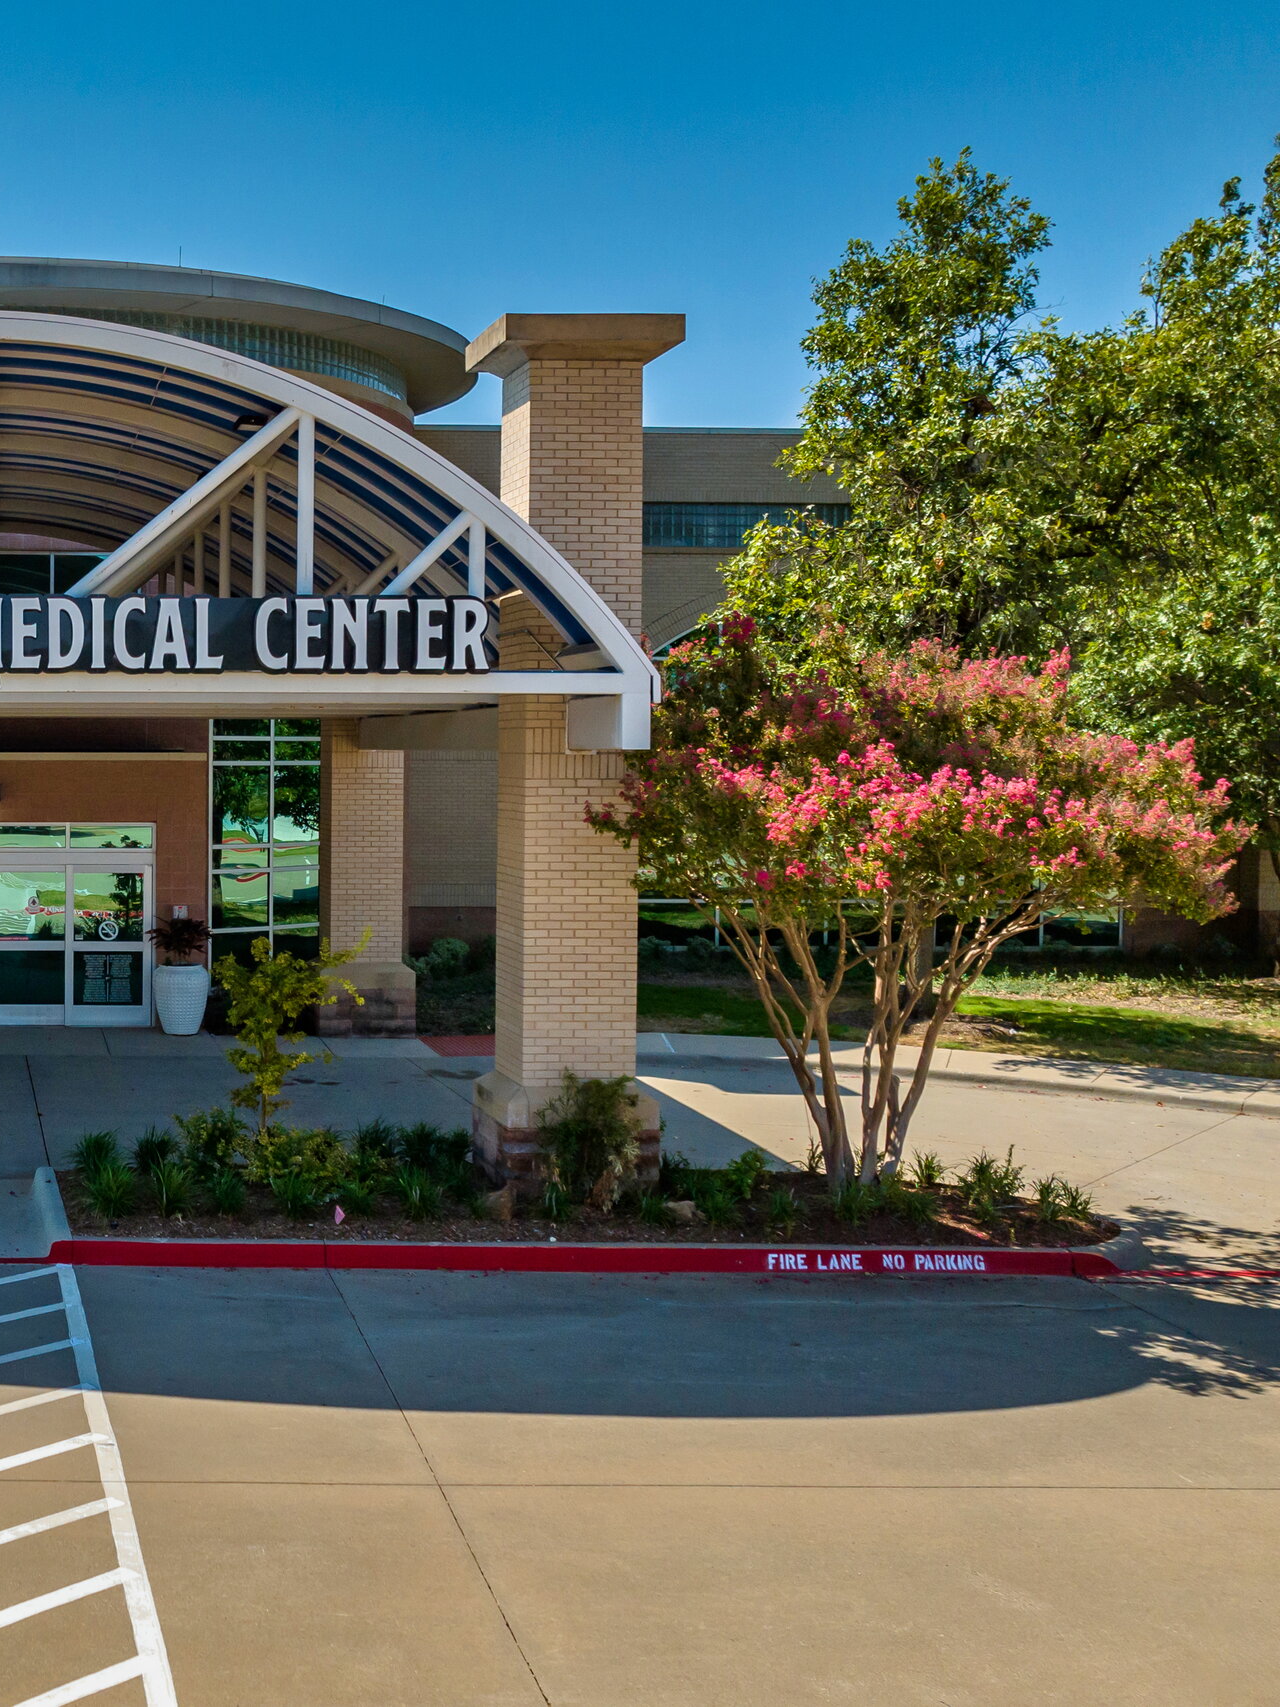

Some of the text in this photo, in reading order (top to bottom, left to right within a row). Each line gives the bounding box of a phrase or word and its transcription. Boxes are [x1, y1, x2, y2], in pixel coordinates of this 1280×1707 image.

[254, 597, 490, 671] CENTER
[767, 1253, 986, 1271] FIRE LANE NO PARKING
